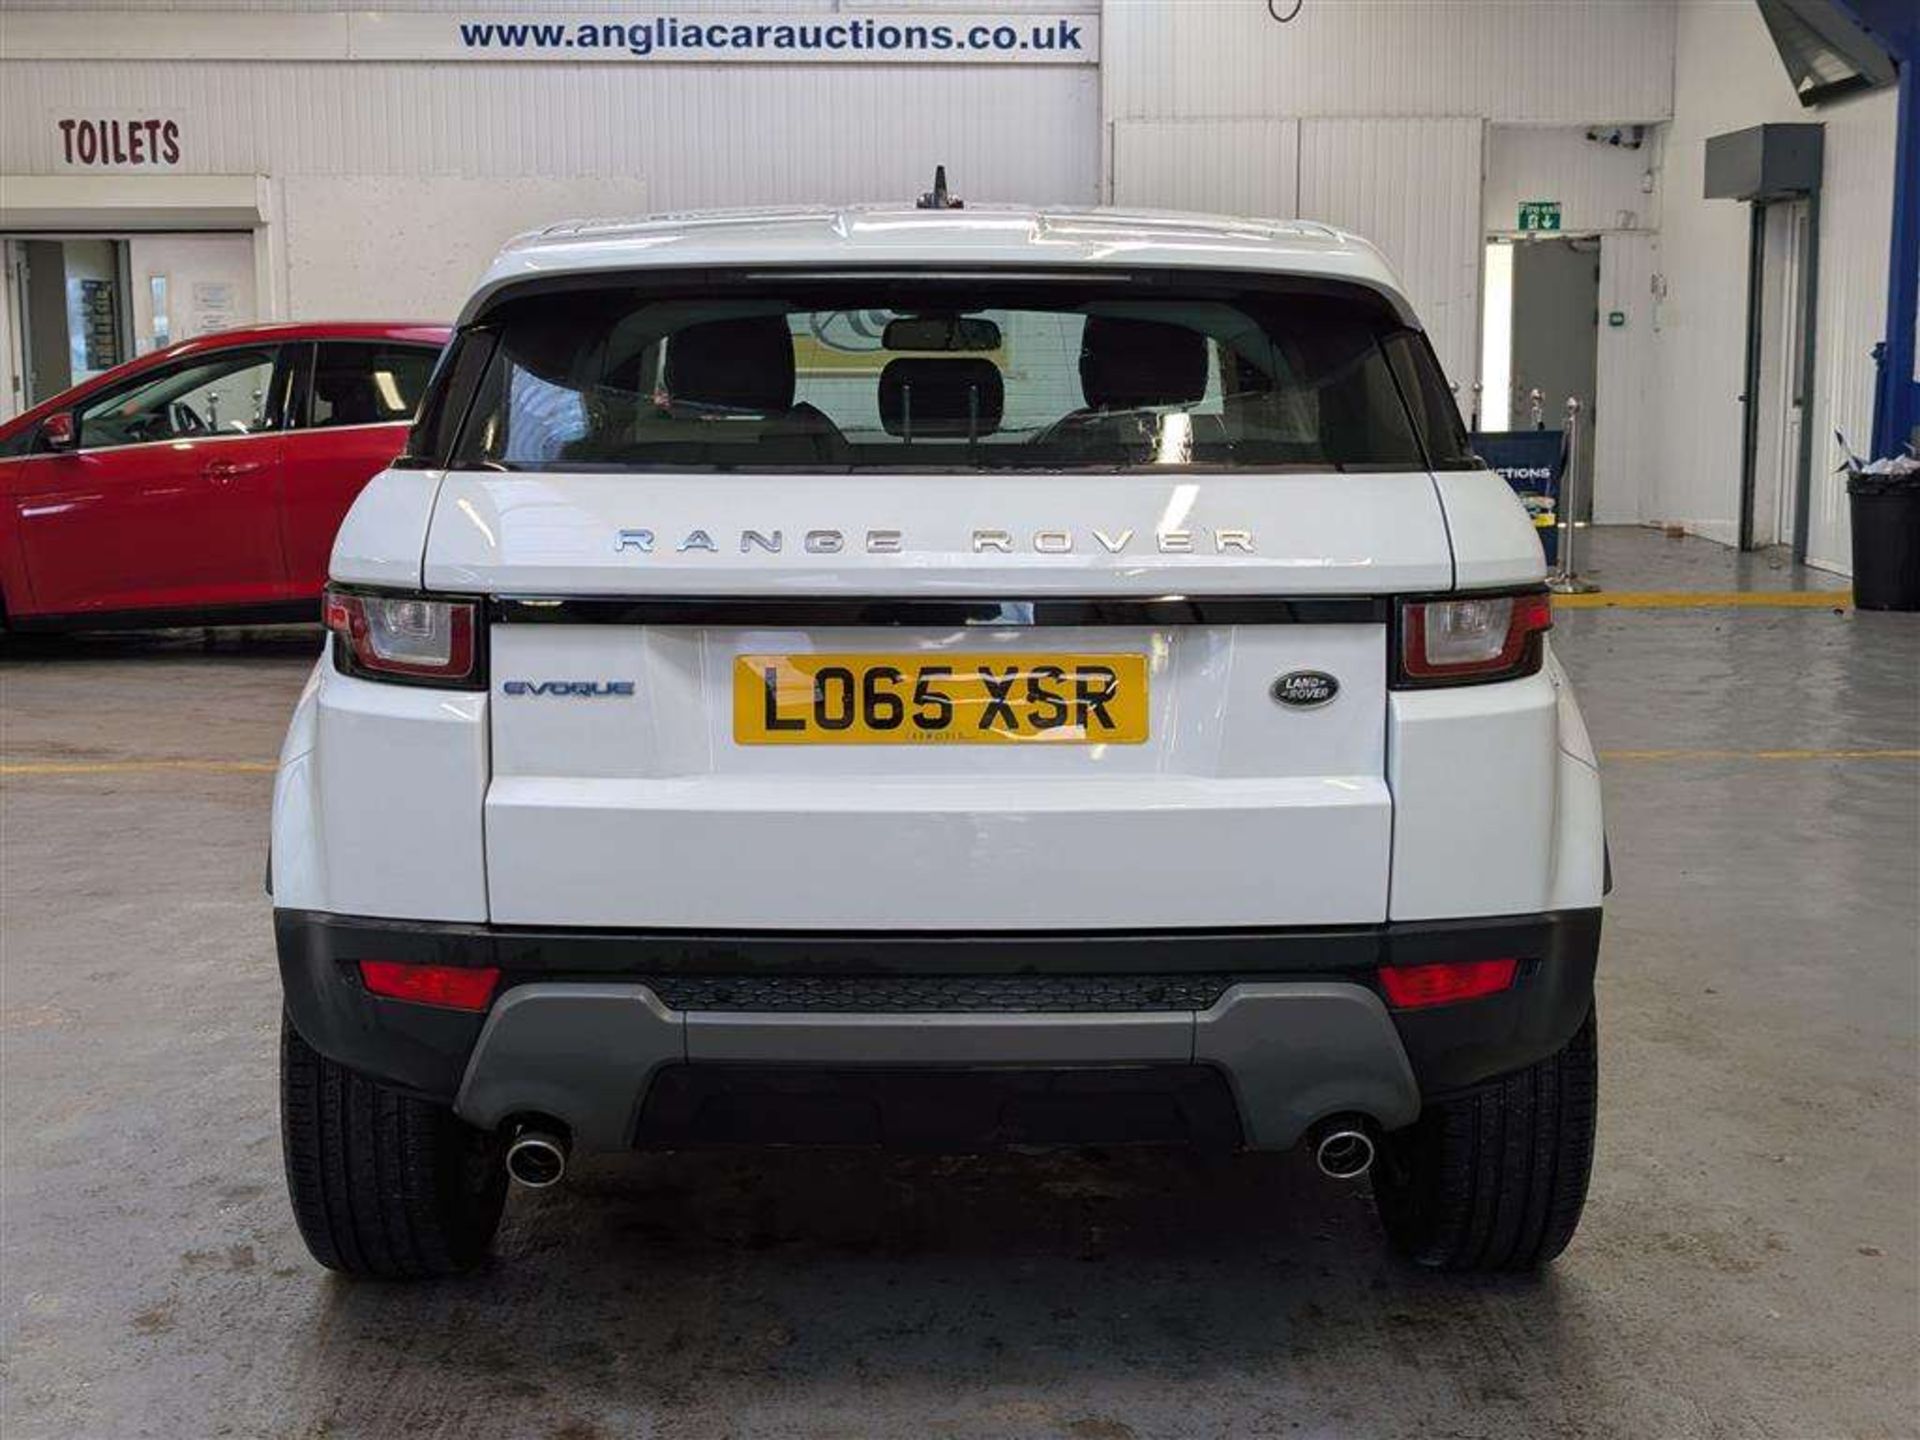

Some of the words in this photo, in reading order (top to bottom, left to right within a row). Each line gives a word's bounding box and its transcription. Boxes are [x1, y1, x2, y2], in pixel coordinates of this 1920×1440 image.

[459, 17, 1082, 55] www.angliacarauctions.co.uk
[58, 119, 180, 165] TOILETS
[615, 529, 903, 553] RANGE
[972, 530, 1257, 553] ROVER
[503, 681, 635, 697] EVOQUE
[764, 665, 953, 731] LO65
[977, 664, 1118, 731] XSR
